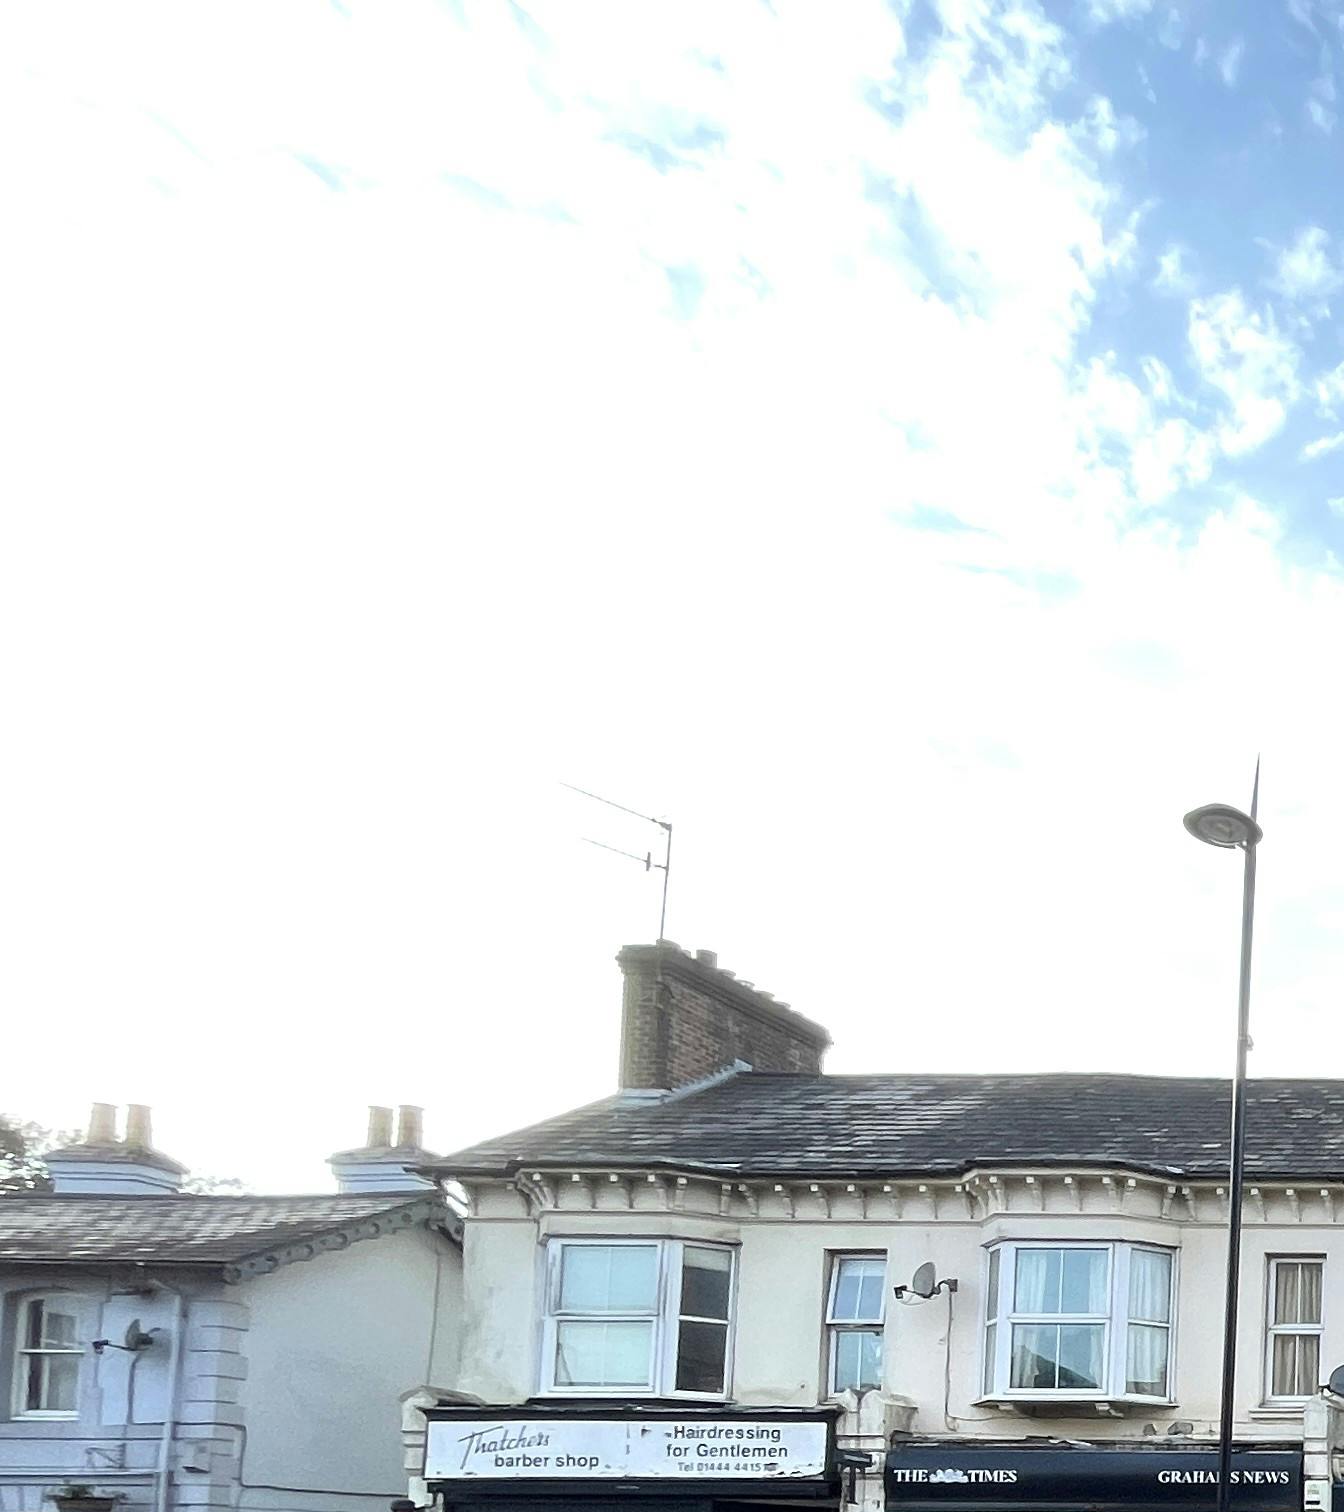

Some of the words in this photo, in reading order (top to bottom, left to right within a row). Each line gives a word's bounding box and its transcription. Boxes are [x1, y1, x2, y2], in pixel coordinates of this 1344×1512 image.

[674, 1426, 781, 1442] Hairdressing
[458, 1425, 550, 1469] Thatchers
[667, 1444, 690, 1457] for
[697, 1444, 788, 1457] Gentlemen
[494, 1454, 549, 1467] barber
[556, 1454, 599, 1470] shop
[678, 1462, 694, 1472] Tel
[697, 1462, 730, 1472] 01444
[735, 1462, 777, 1472] 4415
[894, 1469, 928, 1482] THE
[967, 1469, 1017, 1483] TIMES
[1158, 1471, 1239, 1483] GRAHAS
[1243, 1471, 1289, 1484] NEWS
